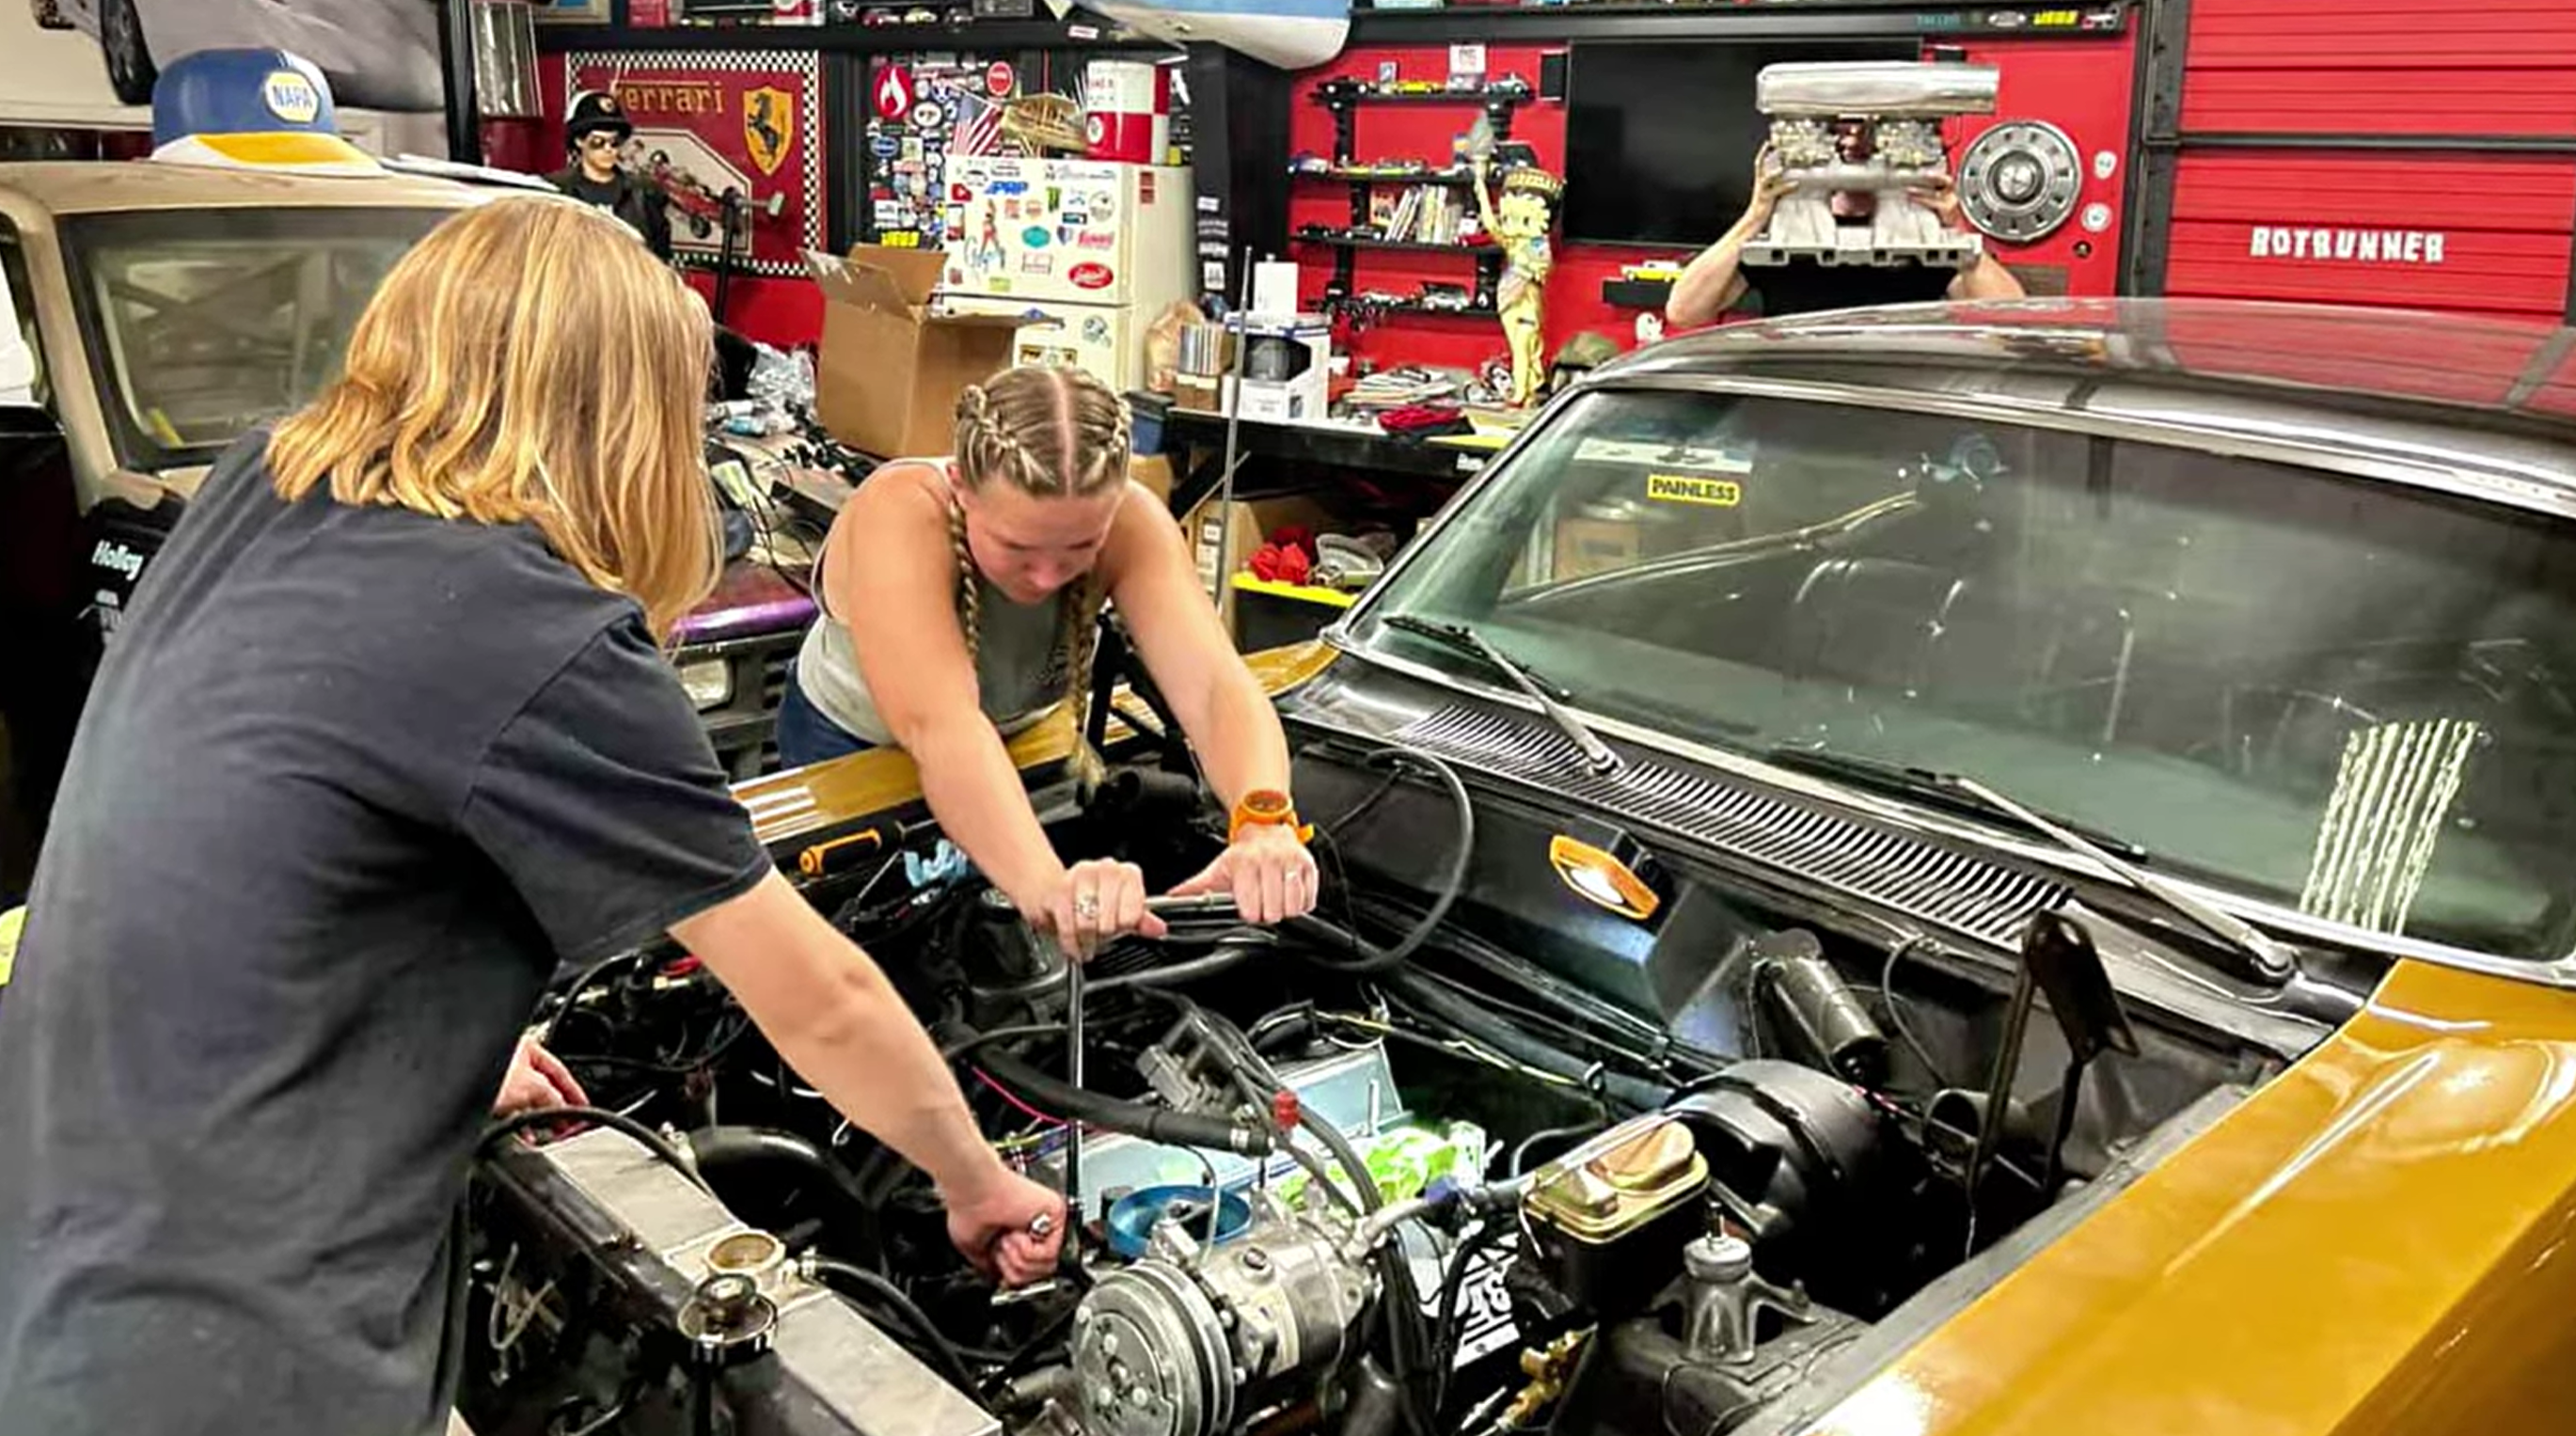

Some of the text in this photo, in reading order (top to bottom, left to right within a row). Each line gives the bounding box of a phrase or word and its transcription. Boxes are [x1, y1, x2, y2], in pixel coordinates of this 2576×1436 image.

[272, 84, 313, 109] NAPA
[1652, 478, 1735, 501] PAINLESS
[91, 539, 144, 581] Holley
